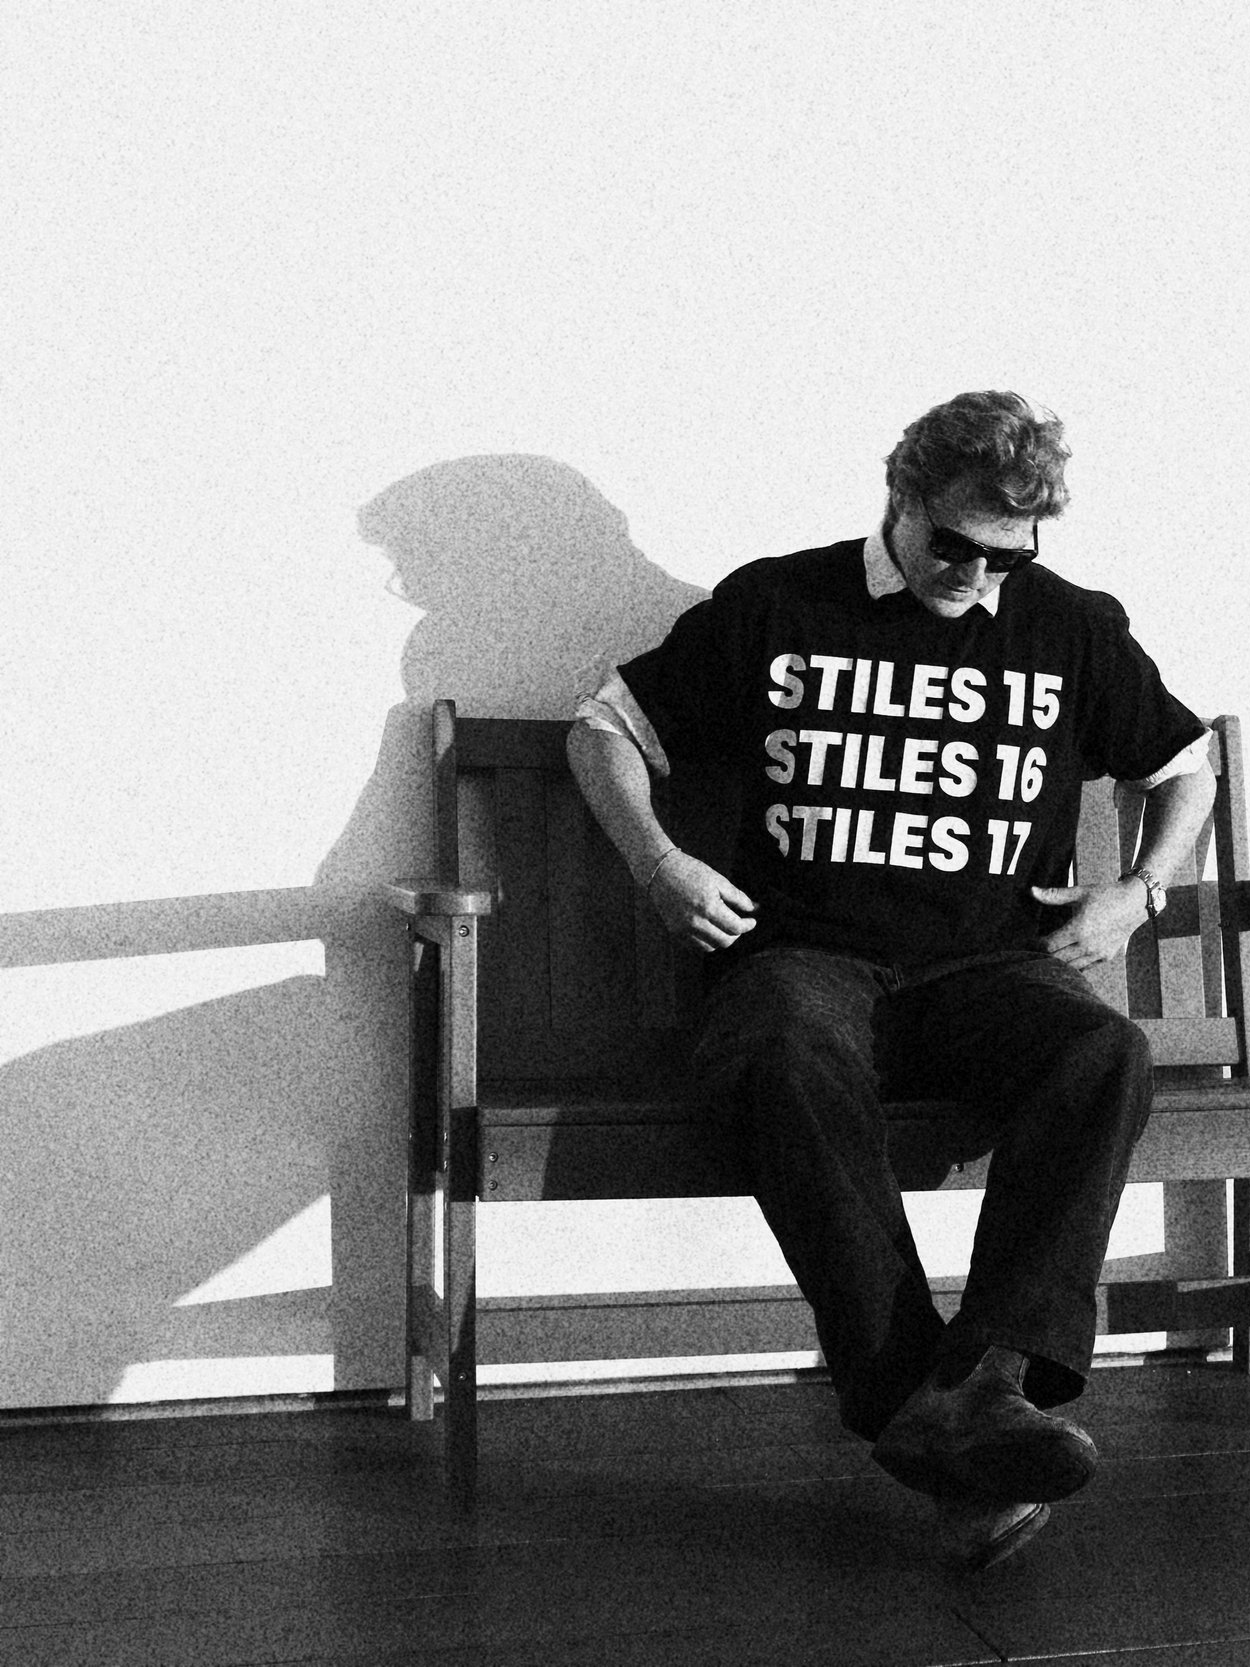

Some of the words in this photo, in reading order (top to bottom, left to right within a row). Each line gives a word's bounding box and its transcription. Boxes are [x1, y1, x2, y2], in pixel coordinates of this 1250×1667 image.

[767, 653, 988, 724] STILES
[1003, 670, 1064, 730] 15
[764, 728, 980, 798] STILES
[996, 744, 1048, 803] 16
[765, 803, 971, 872] STILES
[987, 818, 1033, 876] 17
